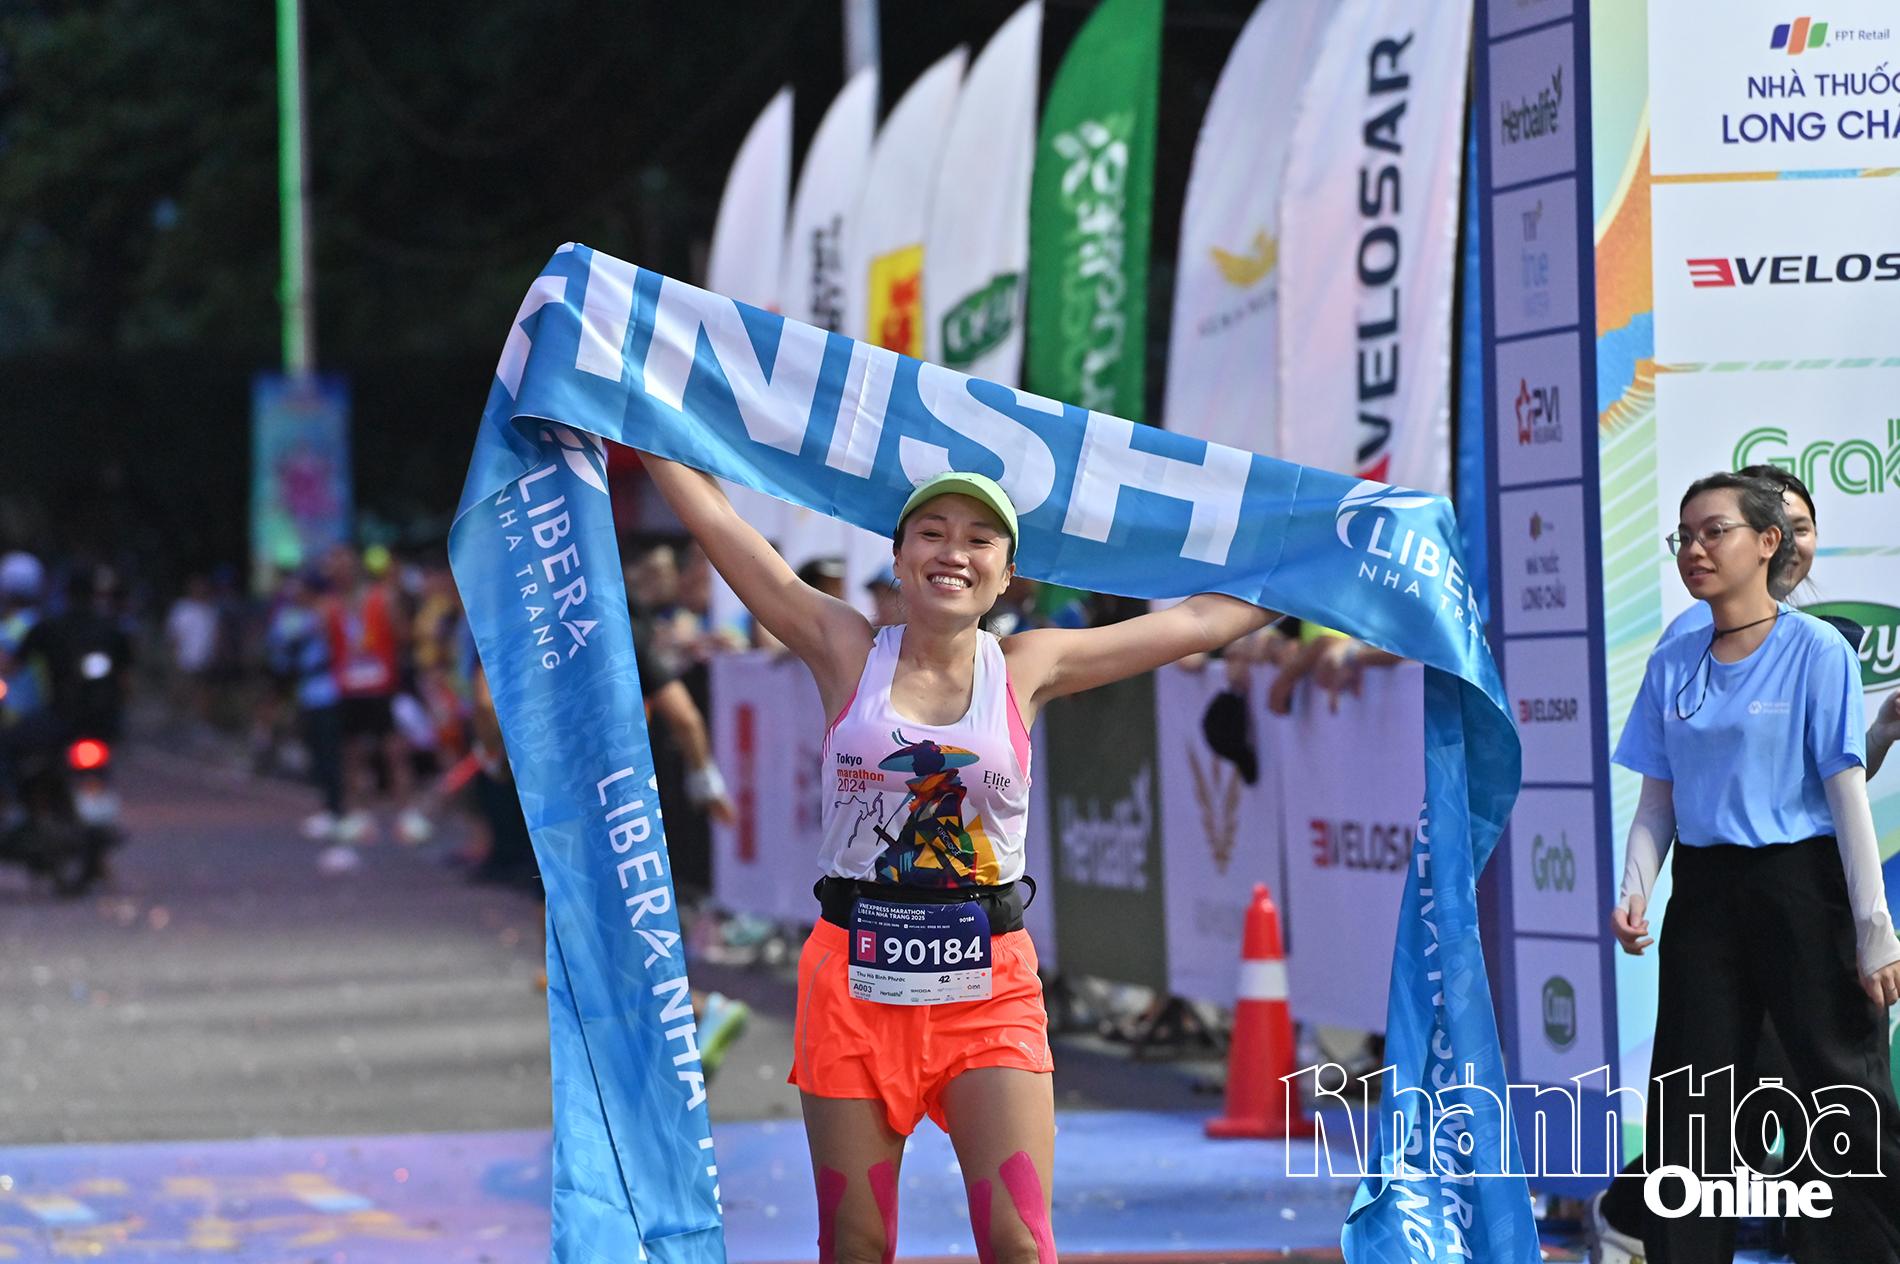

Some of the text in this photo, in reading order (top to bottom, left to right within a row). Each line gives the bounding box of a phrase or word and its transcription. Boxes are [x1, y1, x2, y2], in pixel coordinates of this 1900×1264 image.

[1835, 28, 1890, 41] FPT Retail
[1747, 69, 1806, 99] NHÀ
[1722, 103, 1900, 144] LONG CH
[1355, 30, 1414, 464] VELOSAR
[1732, 418, 1900, 495] Gra
[495, 486, 561, 670] NHA TRANG
[518, 463, 599, 659] LIBERA
[1358, 561, 1420, 598] NHA
[836, 753, 863, 766] Tokyo
[836, 768, 885, 782] marathon
[837, 779, 867, 793] 2024
[983, 769, 1011, 788] Elite
[597, 766, 681, 969] LIBERA
[1532, 832, 1576, 893] Grab
[861, 935, 984, 966] F 90184
[938, 974, 951, 984] 42
[651, 975, 707, 1112] NHA
